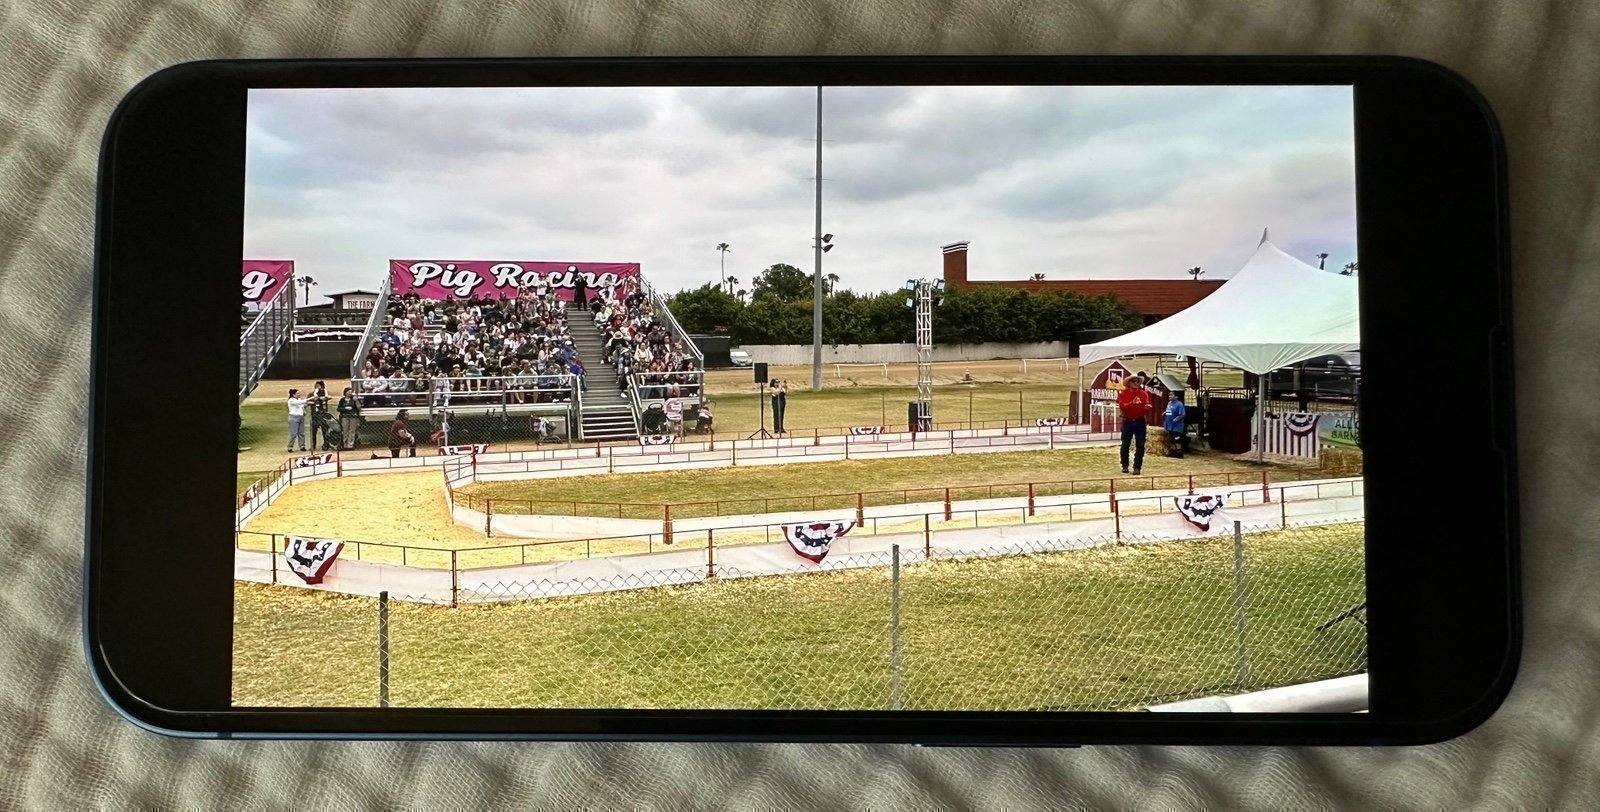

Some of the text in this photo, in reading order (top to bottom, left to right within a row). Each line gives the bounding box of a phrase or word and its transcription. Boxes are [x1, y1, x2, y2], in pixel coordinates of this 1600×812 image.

[408, 262, 623, 299] Pig Racing
[347, 300, 358, 309] THE
[1091, 388, 1118, 400] BARNYARD
[1335, 419, 1352, 429] ALL
